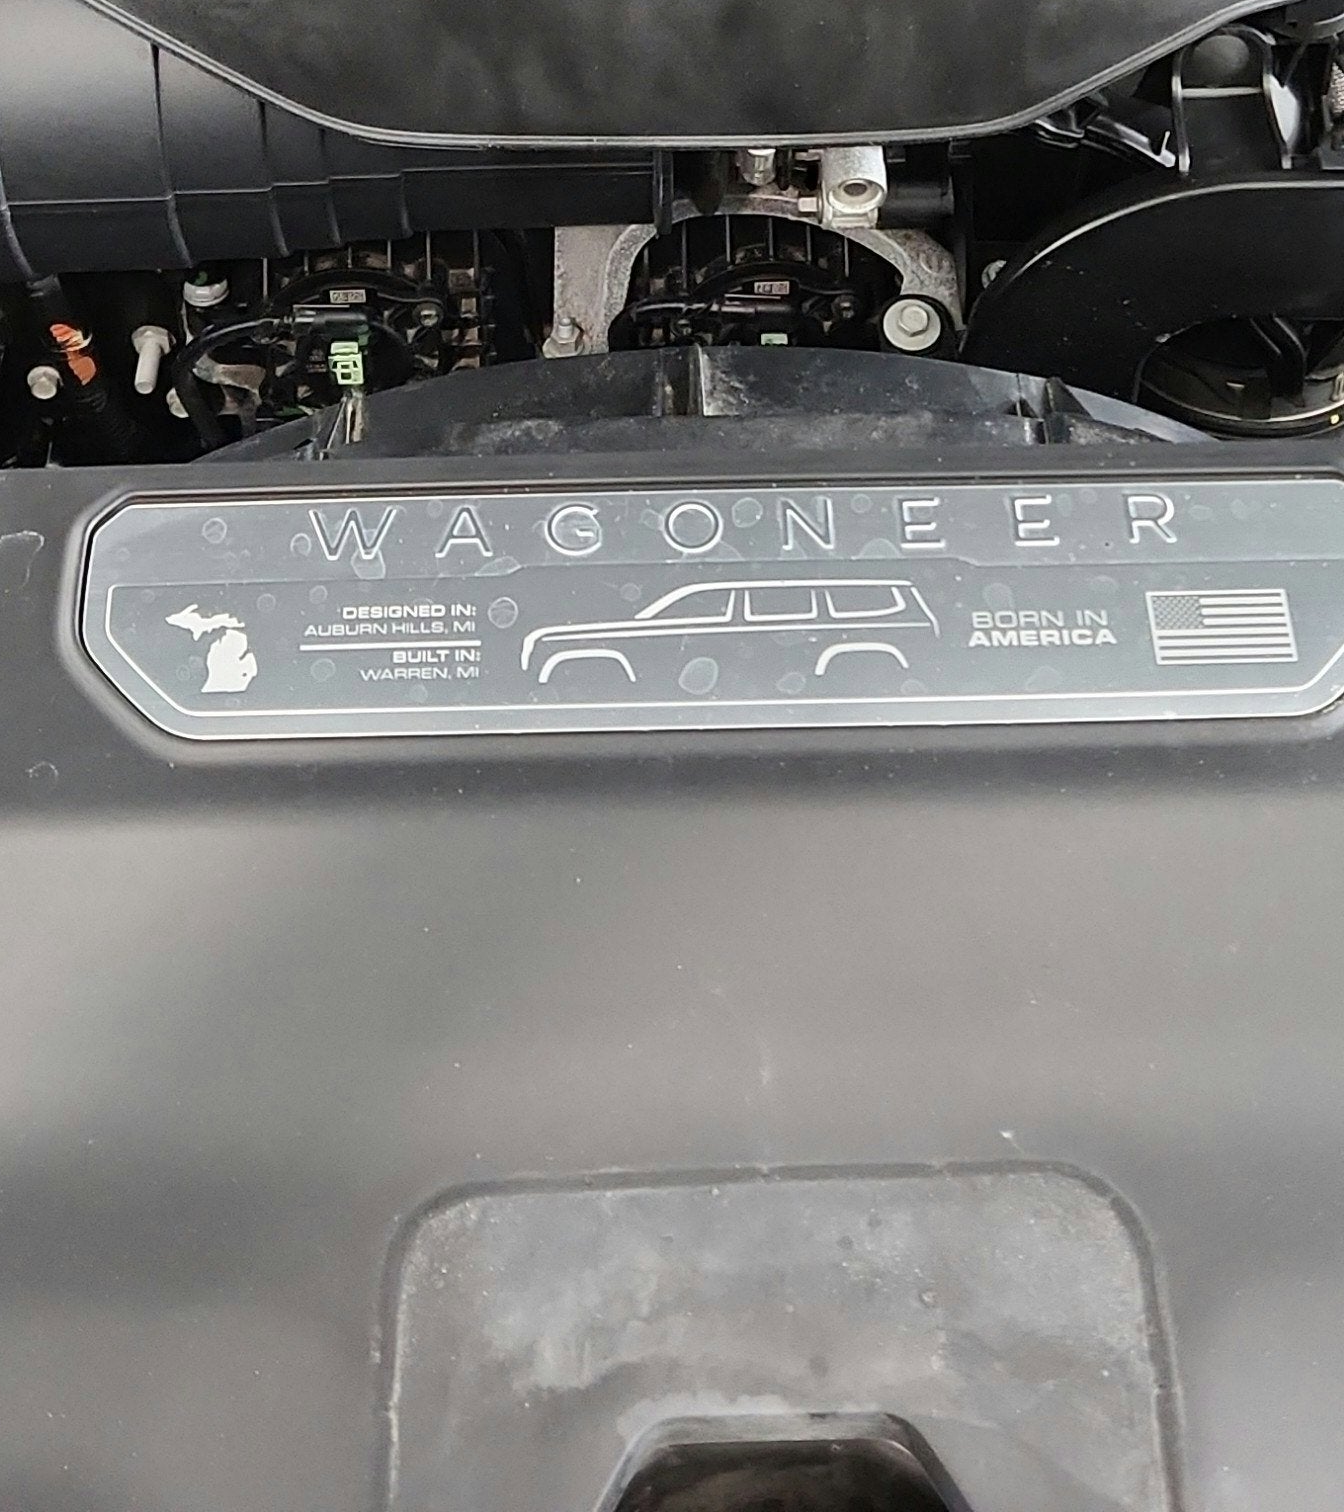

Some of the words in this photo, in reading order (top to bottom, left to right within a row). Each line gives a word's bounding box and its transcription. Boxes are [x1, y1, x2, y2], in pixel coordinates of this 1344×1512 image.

[308, 494, 1177, 560] WAGONEER
[342, 605, 445, 620] DESIGNED
[449, 604, 477, 619] IN:
[972, 610, 1068, 628] BORN
[1076, 608, 1109, 626] IN
[304, 622, 388, 637] AUBURN
[454, 620, 476, 633] MI
[968, 627, 1117, 648] AMERICA
[392, 650, 450, 664] BUILT
[454, 648, 481, 663] IN:
[359, 666, 452, 682] WARREN,
[456, 665, 481, 680] MI
